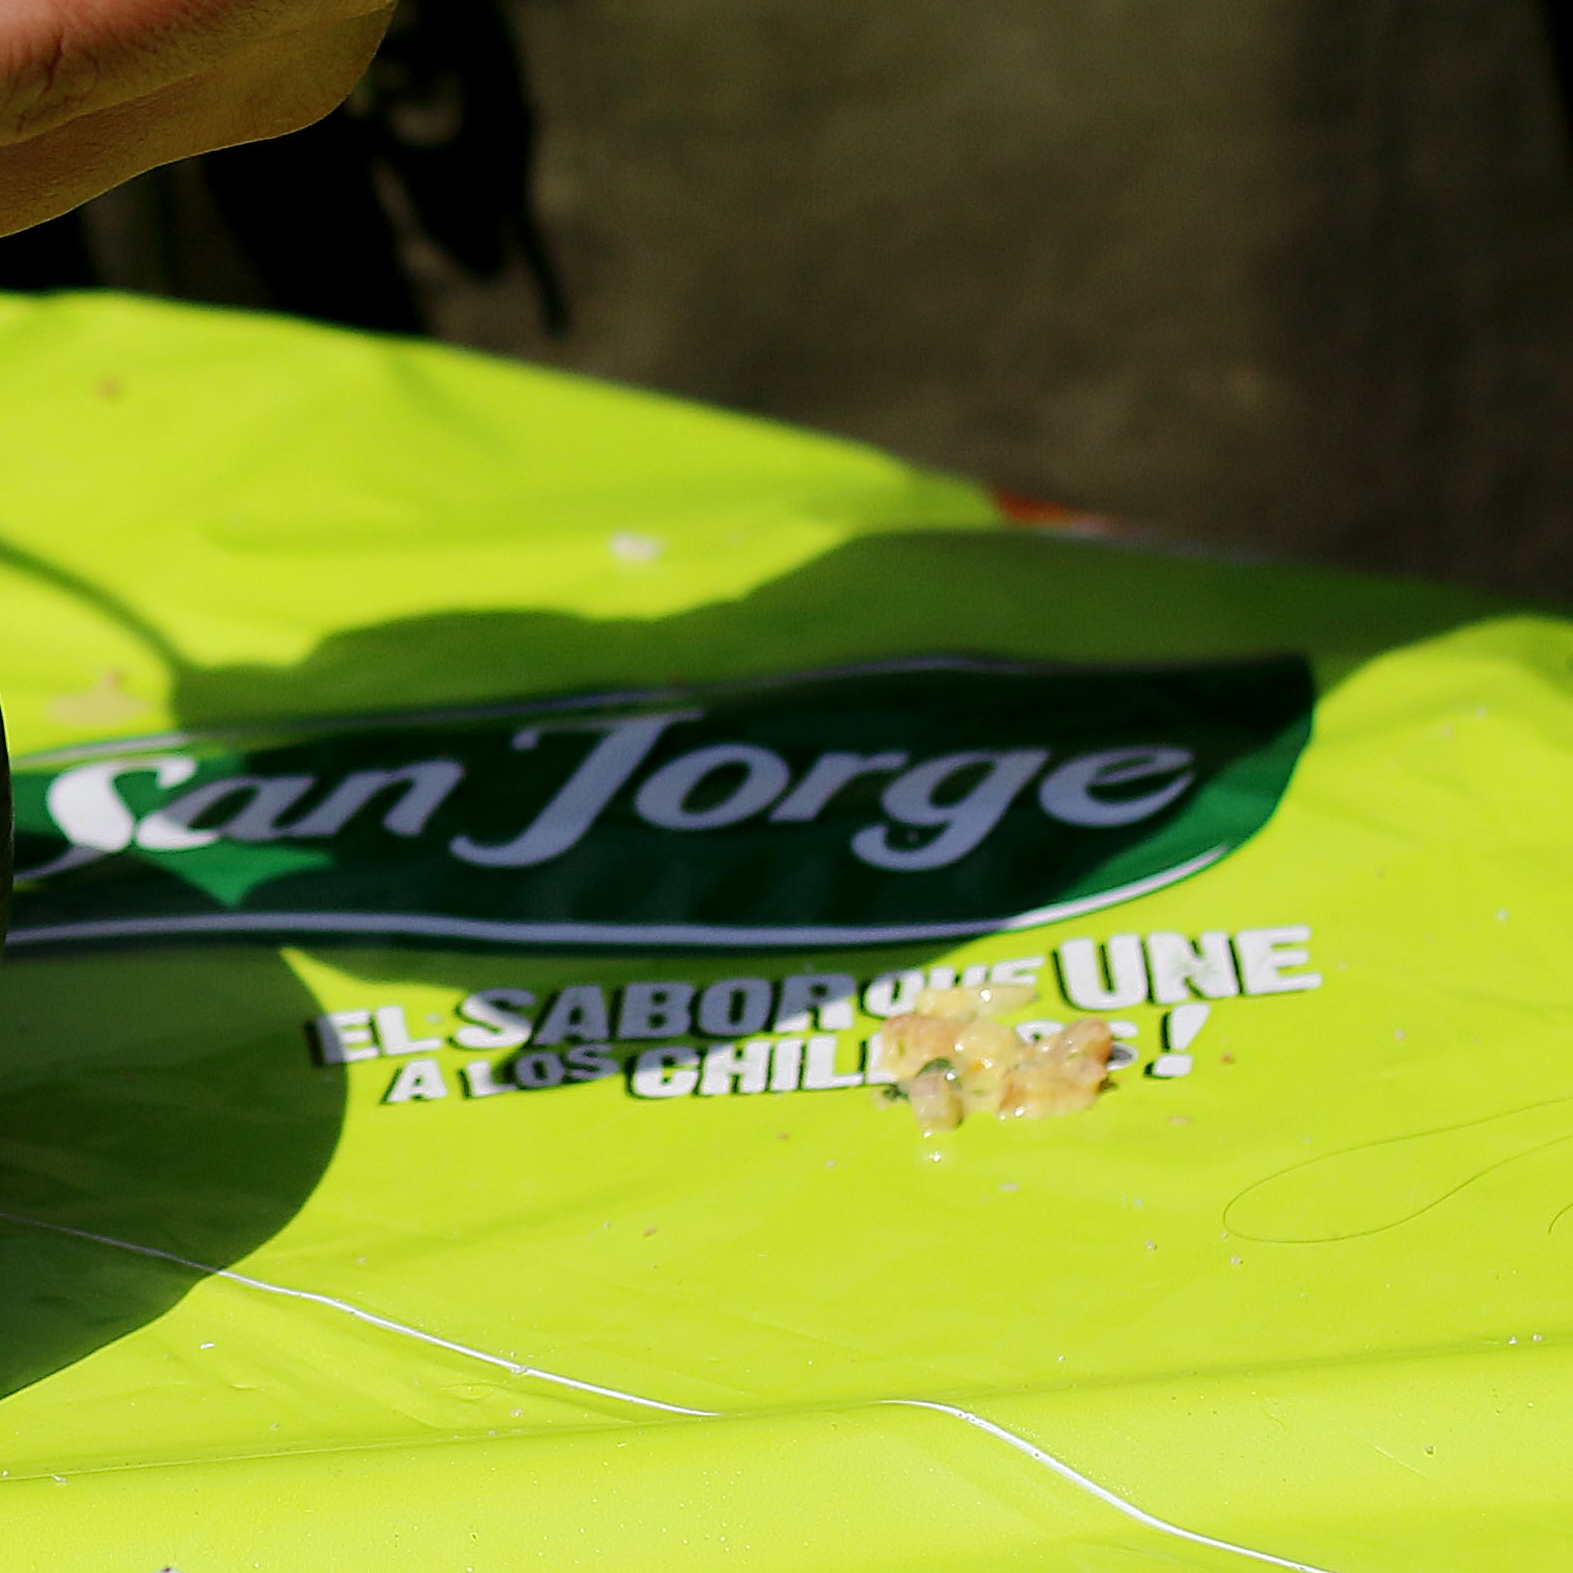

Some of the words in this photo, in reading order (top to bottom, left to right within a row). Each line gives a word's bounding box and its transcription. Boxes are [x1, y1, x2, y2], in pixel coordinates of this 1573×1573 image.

[14, 753, 464, 881] San
[451, 710, 1198, 871] Jorge
[320, 1005, 444, 1065] EL
[456, 973, 854, 1049] SABOR
[1060, 924, 1324, 1011] UNE
[386, 1058, 449, 1104] A
[467, 1043, 620, 1098] LOS
